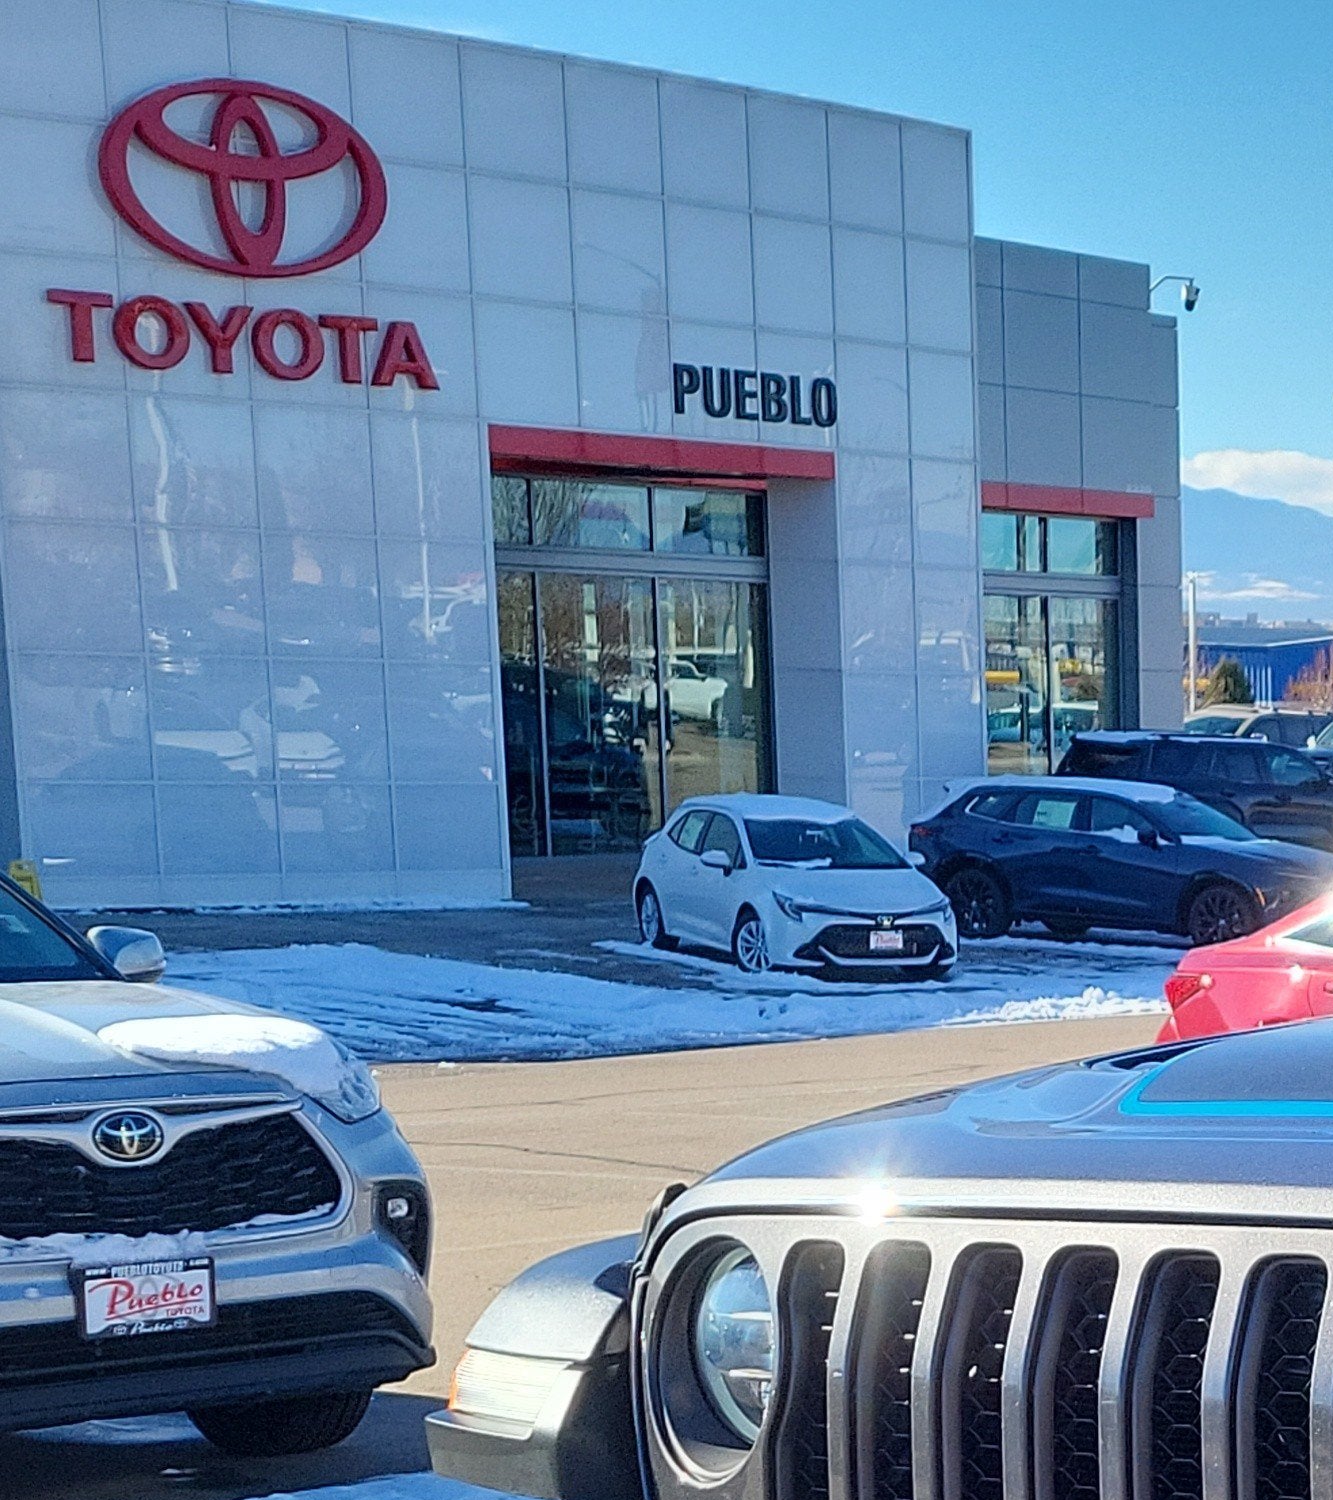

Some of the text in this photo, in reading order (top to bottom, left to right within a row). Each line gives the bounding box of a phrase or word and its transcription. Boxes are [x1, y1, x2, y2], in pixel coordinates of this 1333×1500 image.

[46, 288, 440, 390] TOYOTA
[672, 362, 838, 428] PUEBLO
[88, 1279, 203, 1315] Pueblo
[166, 1304, 205, 1317] TOYOTA
